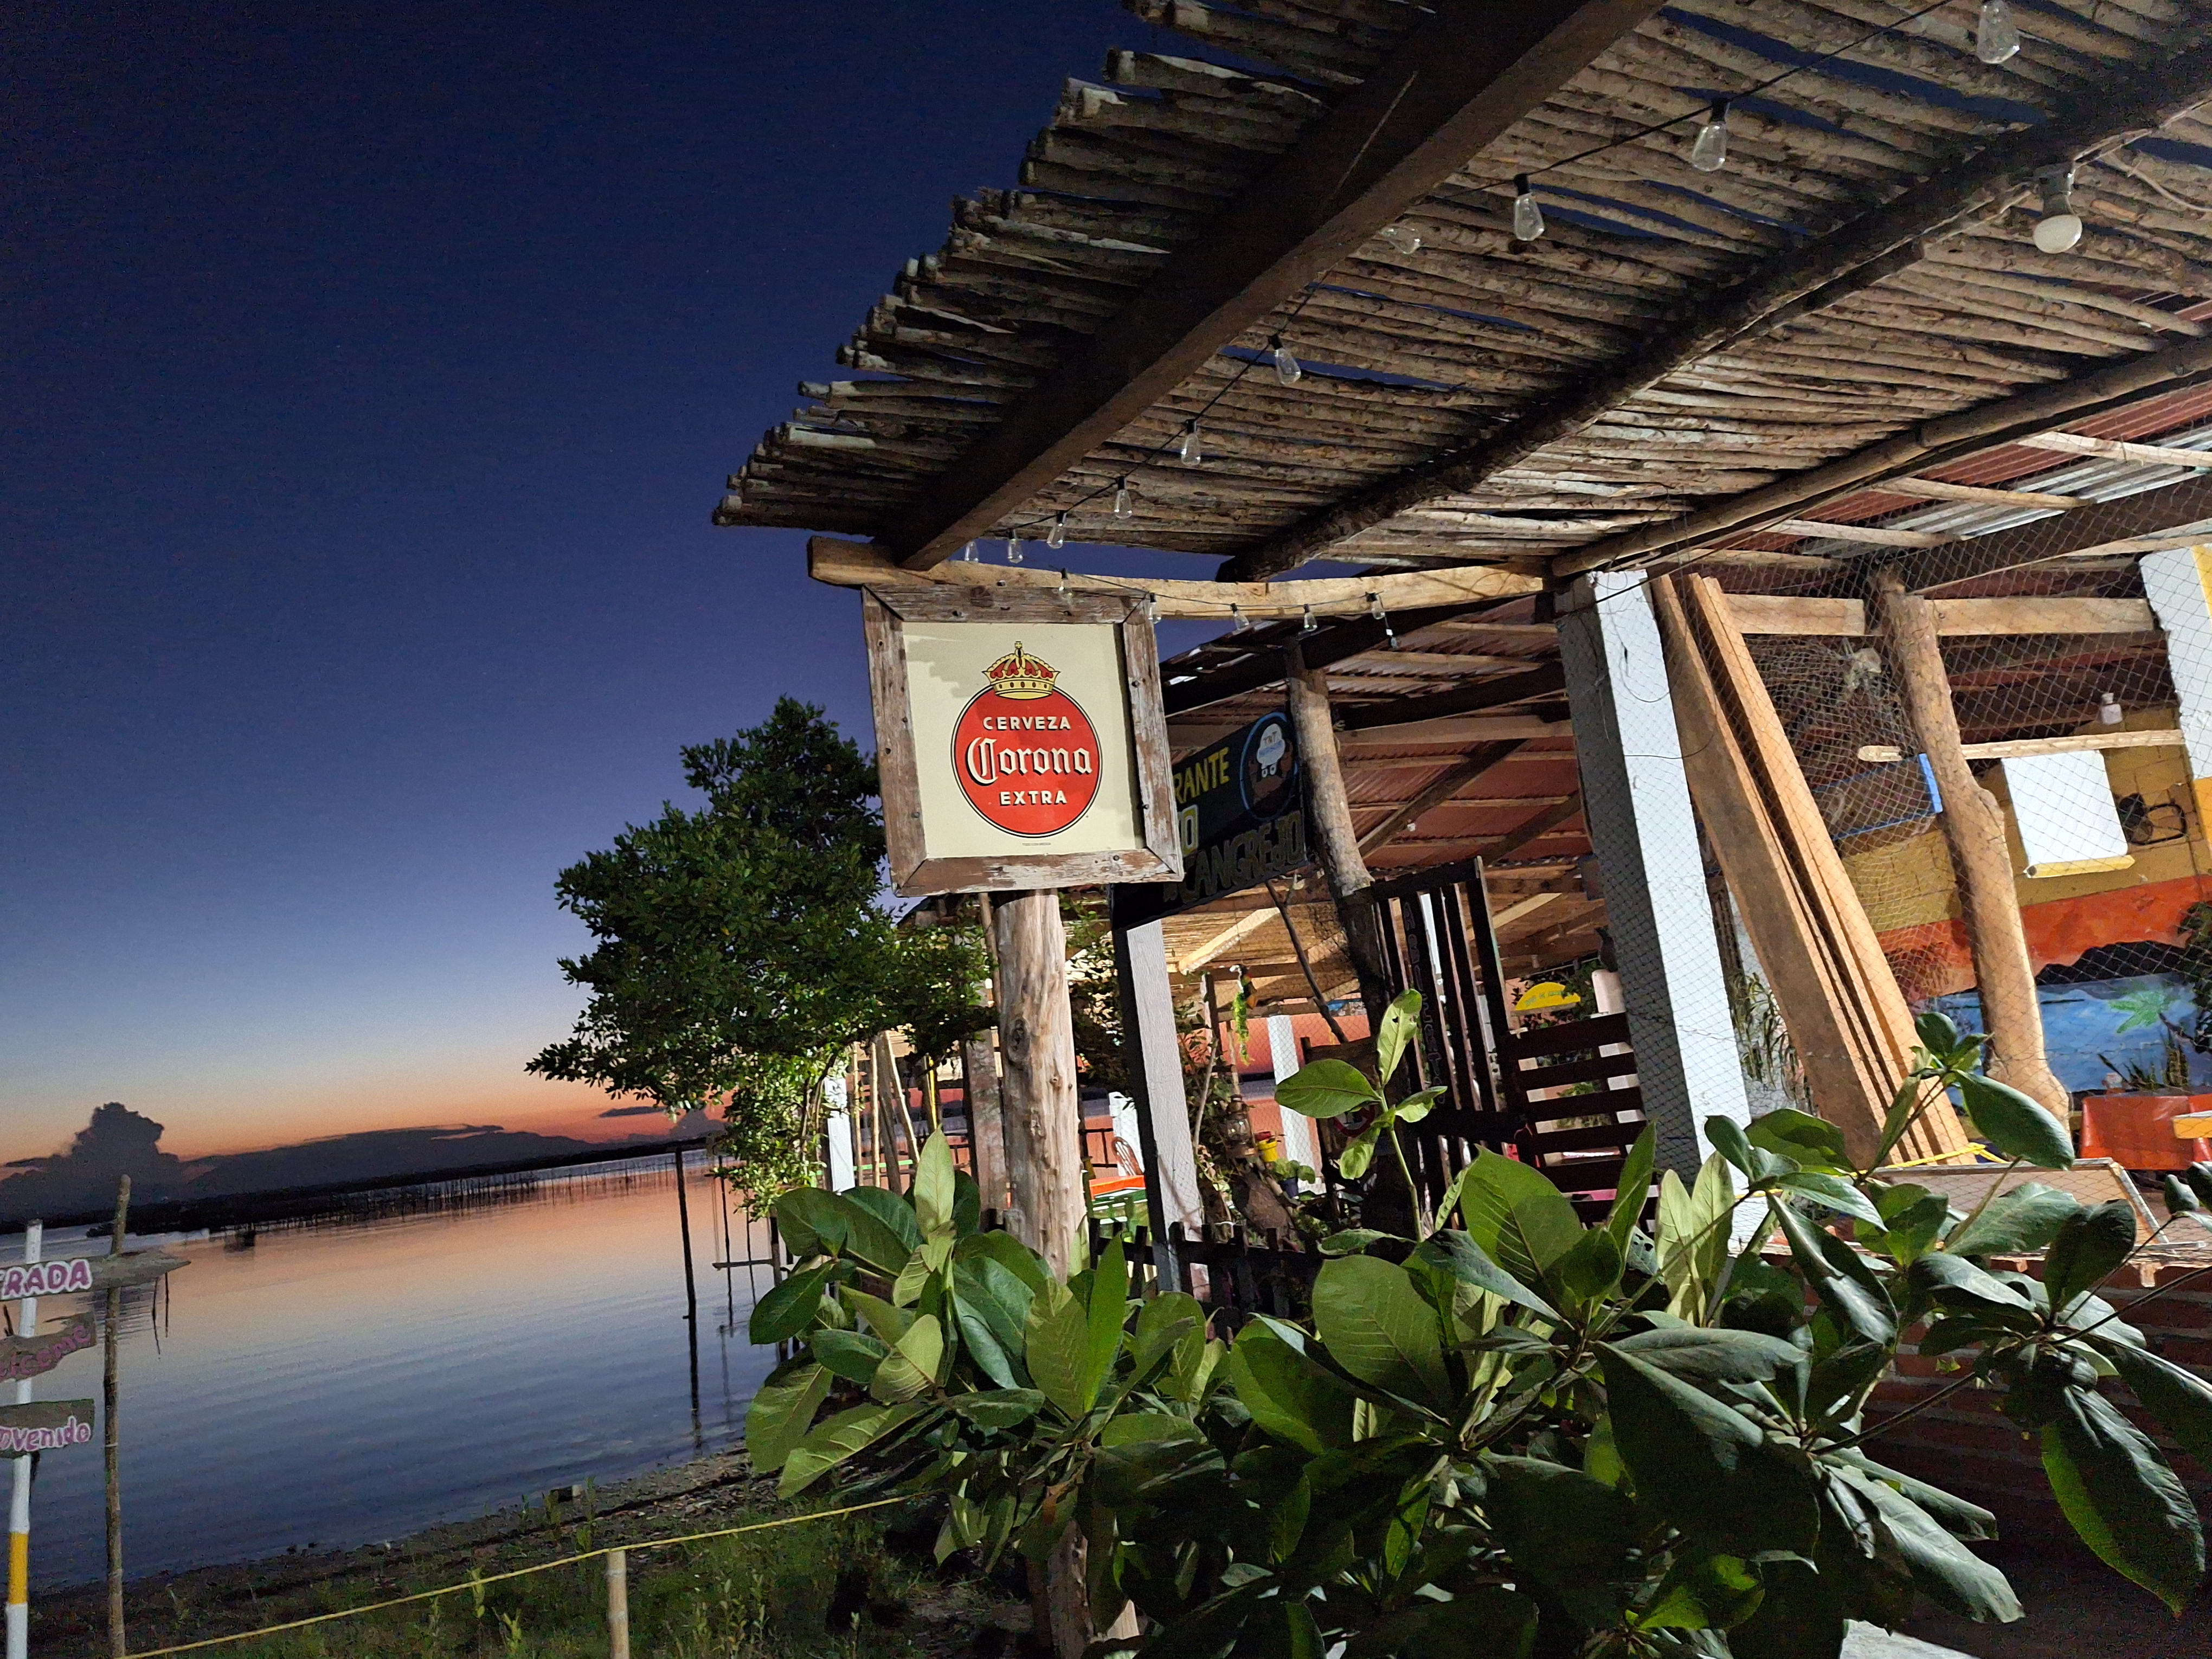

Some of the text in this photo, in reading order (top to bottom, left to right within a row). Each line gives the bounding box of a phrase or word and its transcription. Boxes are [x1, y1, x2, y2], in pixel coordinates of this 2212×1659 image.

[983, 716, 1071, 730] CERVEZA
[966, 736, 1092, 786] Corona
[1000, 790, 1068, 806] EXTRA
[0, 1259, 93, 1300] RADA
